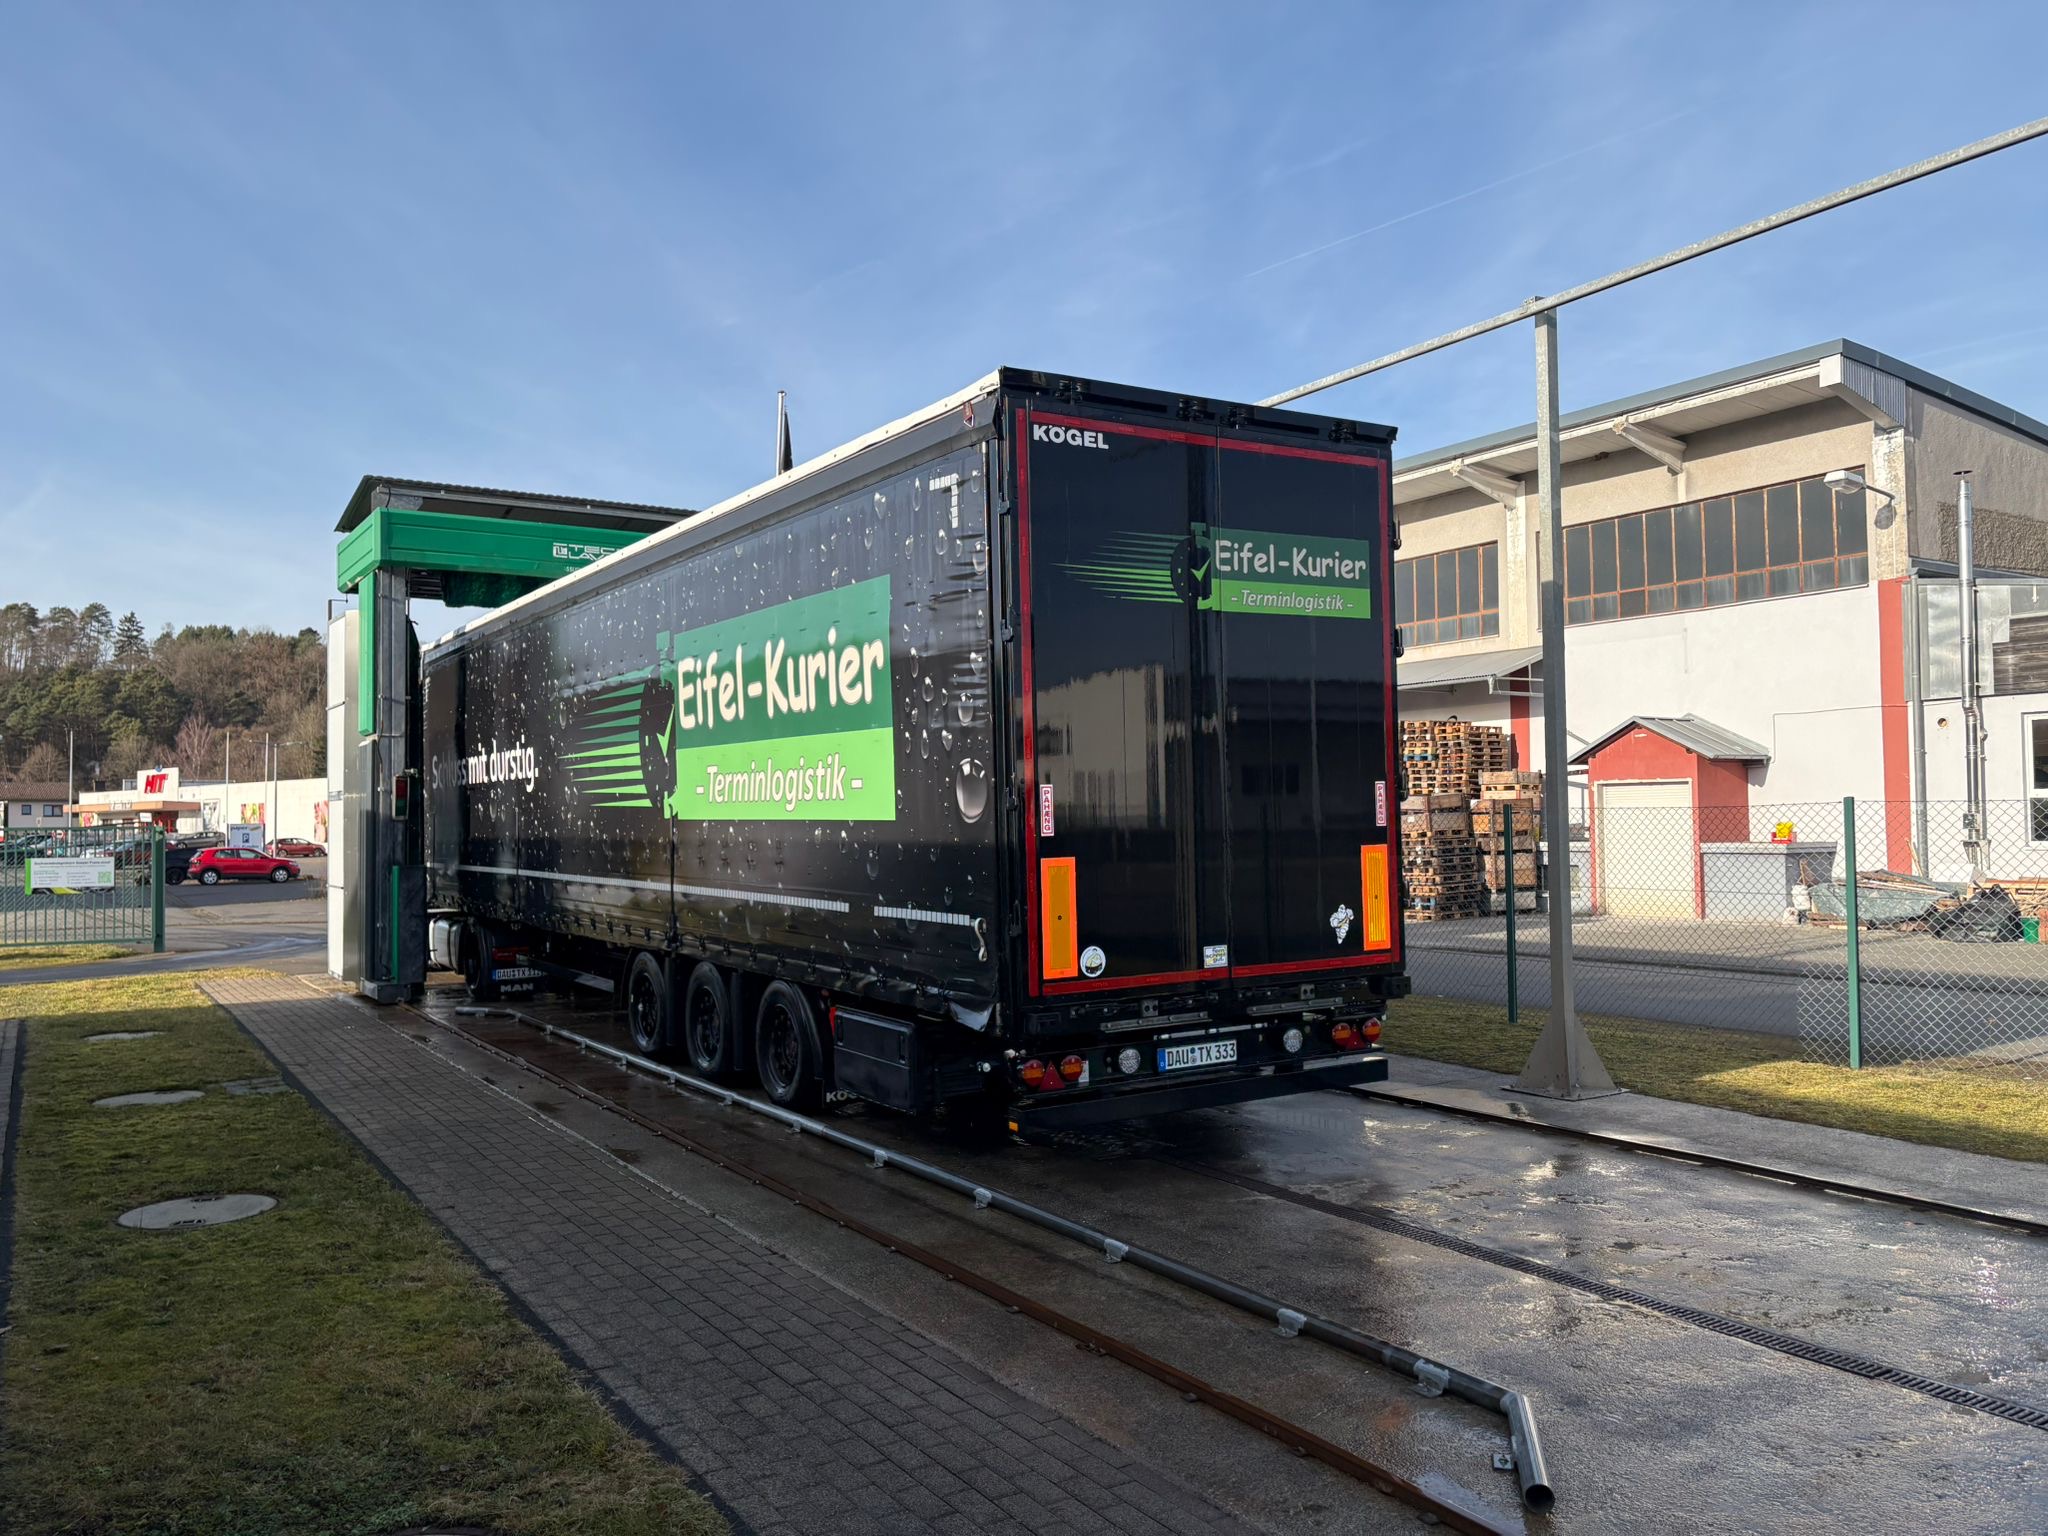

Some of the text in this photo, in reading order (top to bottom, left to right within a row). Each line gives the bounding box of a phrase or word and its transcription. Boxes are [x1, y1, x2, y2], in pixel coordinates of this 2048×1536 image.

[1033, 424, 1109, 449] KÖGEL
[1215, 540, 1366, 580] Eifel-Kurier
[1241, 590, 1344, 612] Terminlogistik
[677, 626, 884, 730] Eifel-Kurier
[467, 742, 488, 785] mit
[489, 734, 539, 793] durstig.
[144, 774, 168, 794] HIT
[500, 983, 534, 992] MAN
[1167, 1049, 1189, 1067] DAU
[1197, 1045, 1212, 1062] TX
[1214, 1043, 1236, 1060] 333
